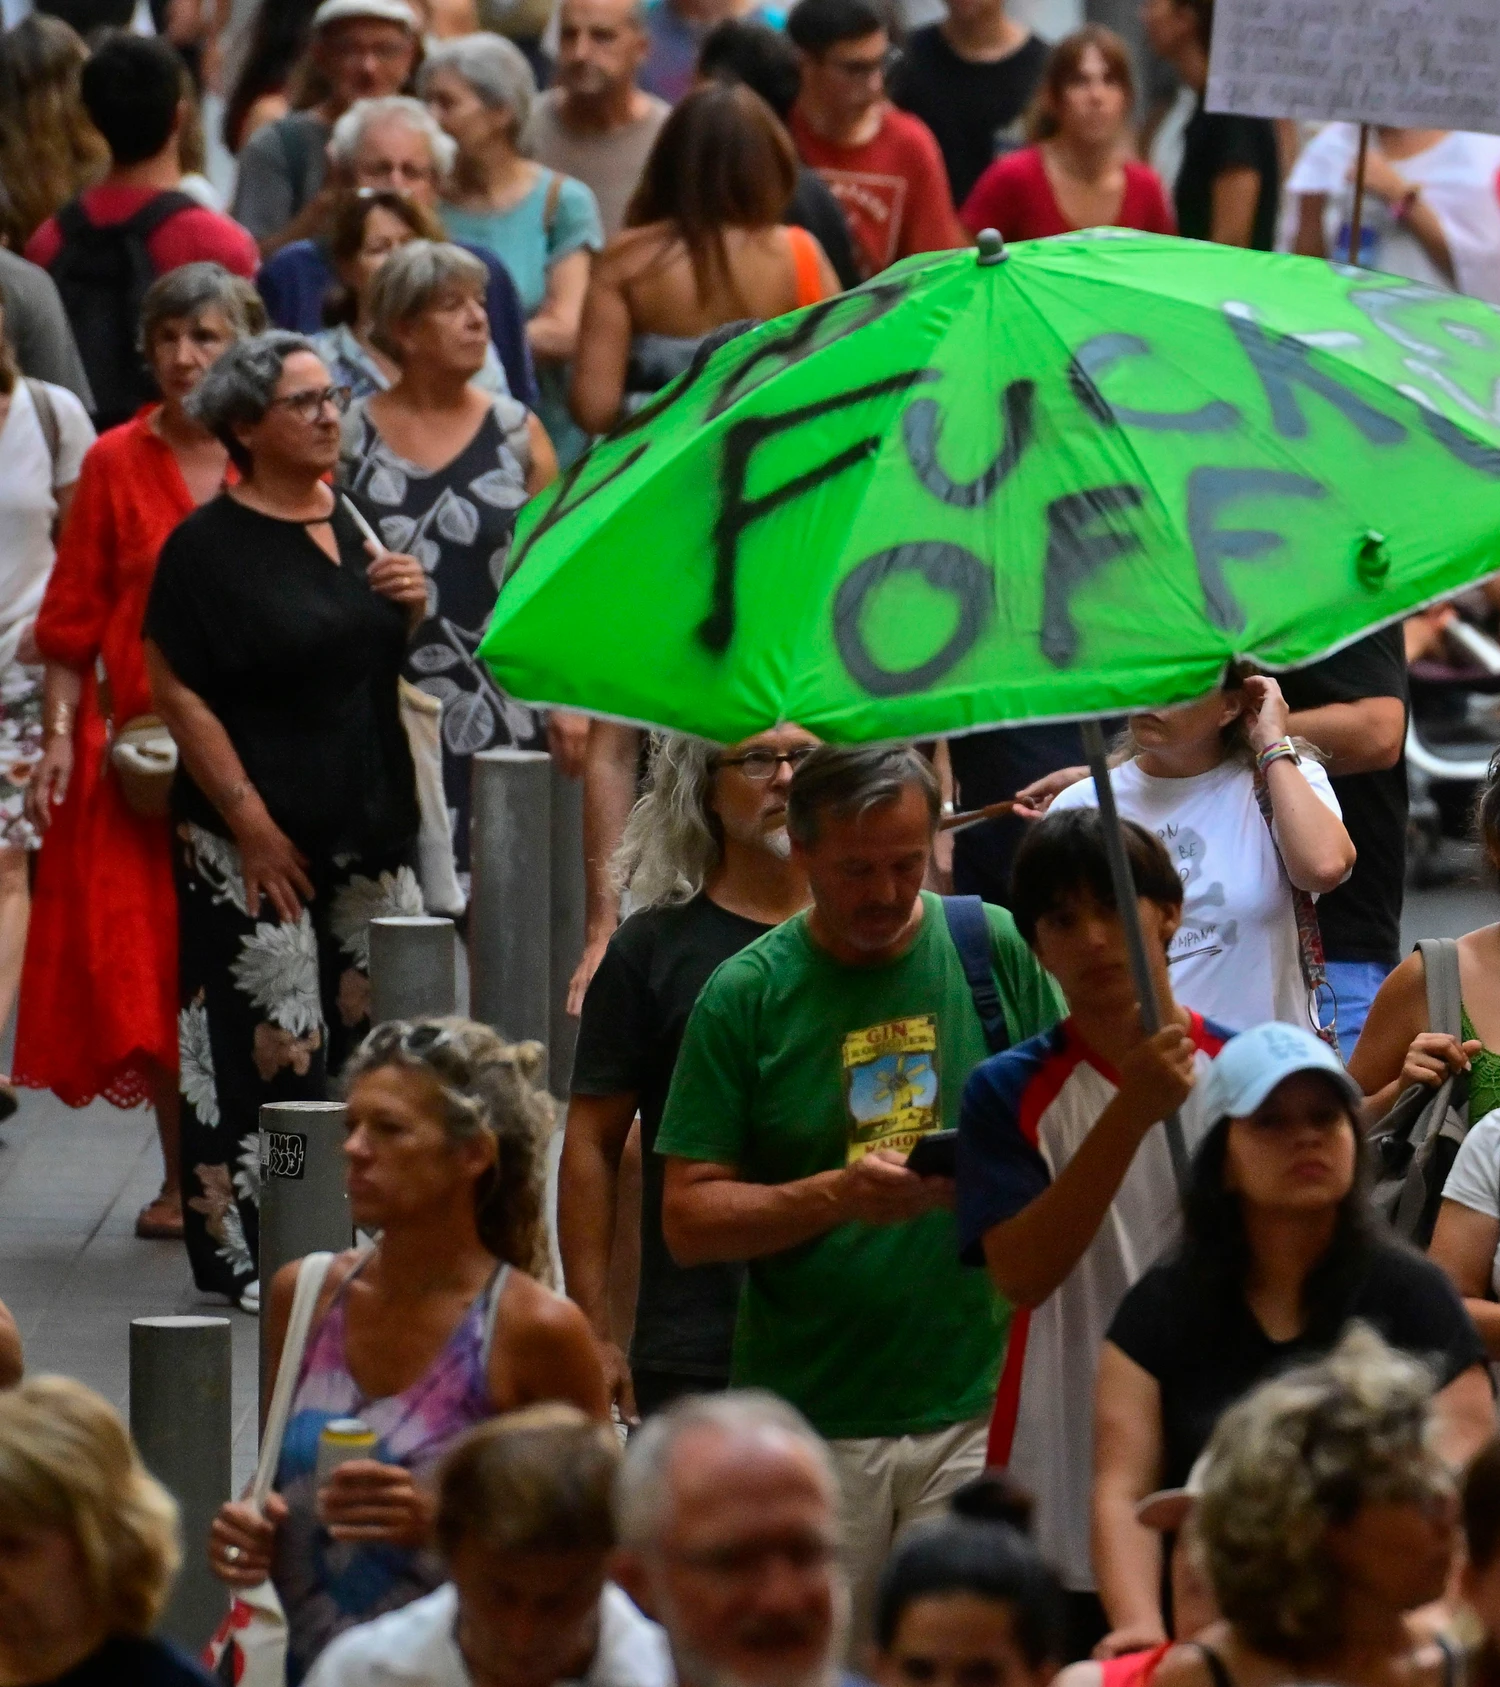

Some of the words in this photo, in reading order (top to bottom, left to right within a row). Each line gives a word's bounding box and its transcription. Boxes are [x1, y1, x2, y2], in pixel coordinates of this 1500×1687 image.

[694, 298, 1410, 652] FUCK
[832, 468, 1325, 697] OFF
[1178, 842, 1198, 860] BE
[1169, 924, 1218, 951] OMPANY
[865, 1021, 909, 1045] GIN
